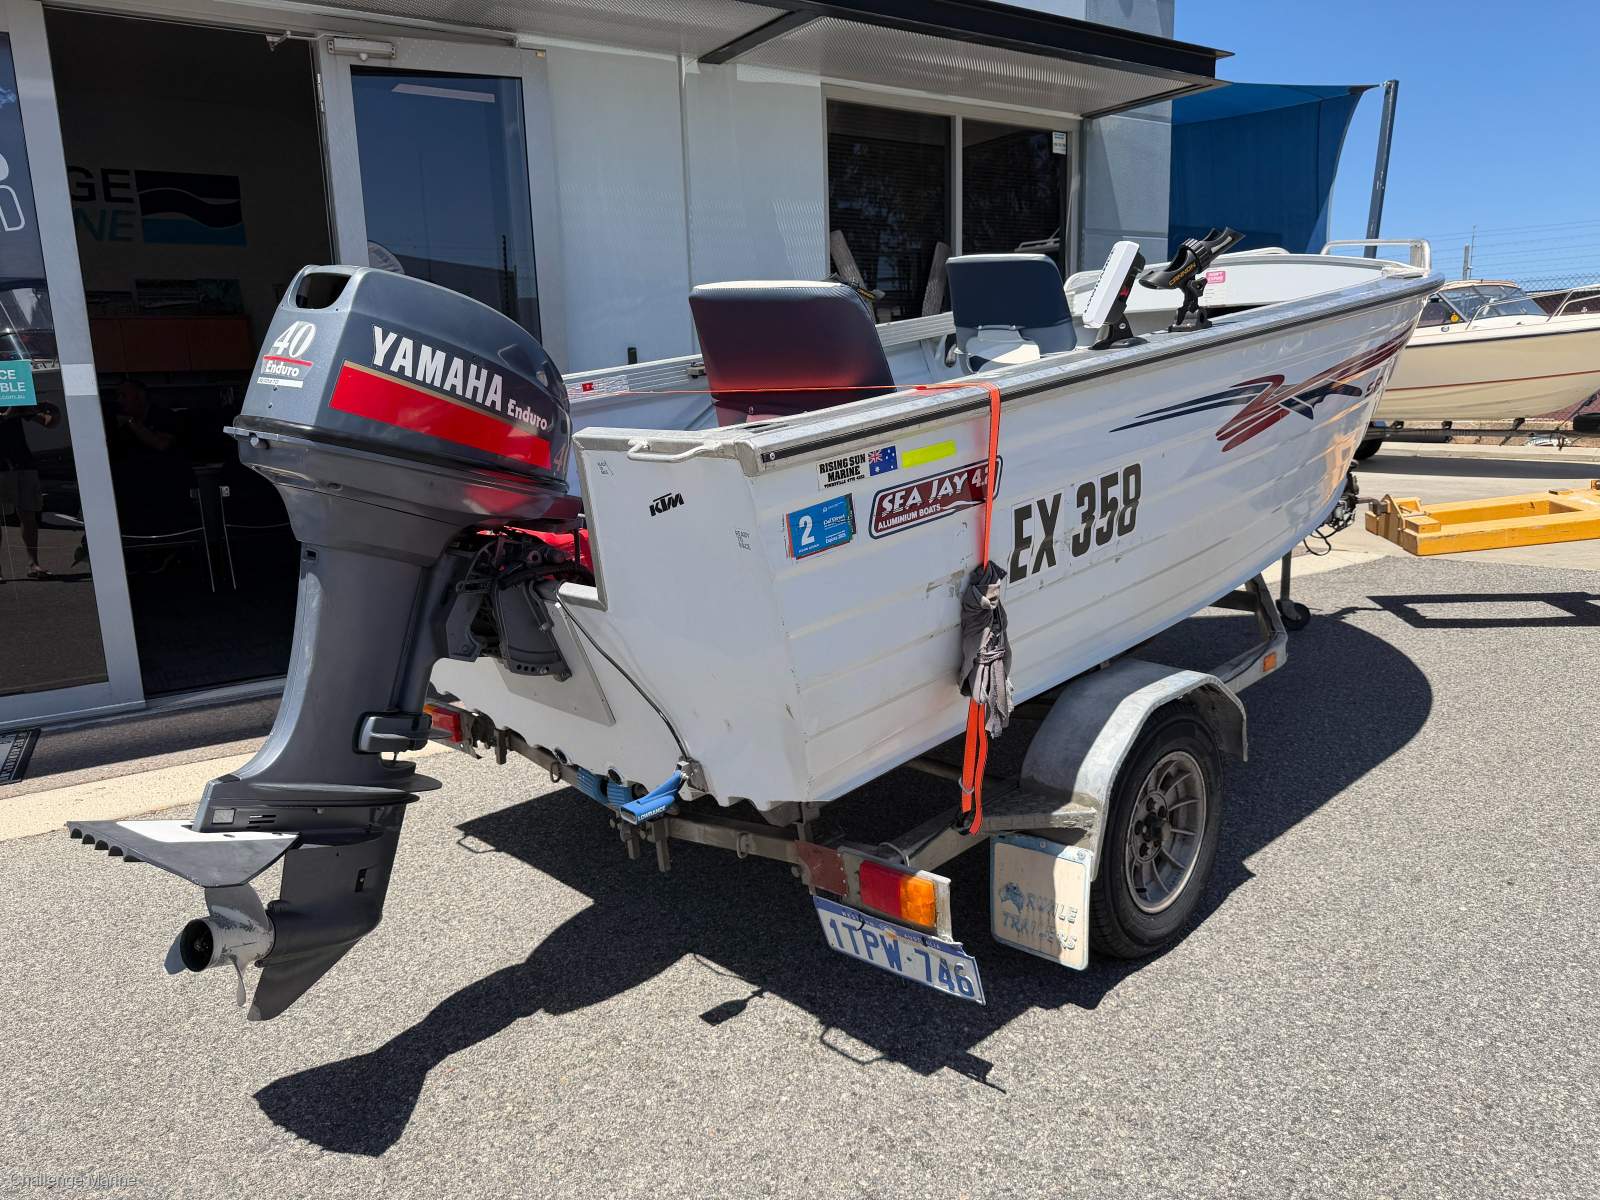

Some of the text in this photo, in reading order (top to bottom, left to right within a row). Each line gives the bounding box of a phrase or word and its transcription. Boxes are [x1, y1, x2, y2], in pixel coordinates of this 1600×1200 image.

[1168, 261, 1197, 287] CANNON
[272, 320, 317, 358] 40
[264, 360, 300, 377] Enduro
[373, 325, 503, 412] YAMAHA
[507, 398, 548, 431] Enduro
[819, 453, 866, 474] RISING SUN
[827, 465, 860, 483] MARINE
[648, 492, 685, 517] KTM
[881, 486, 923, 518] SEA
[928, 472, 968, 504] JAY
[798, 514, 815, 546] 2
[877, 503, 941, 531] ALUMINIUM BOATS
[1009, 462, 1142, 584] EX 358
[903, 932, 941, 950] AUSTALIA
